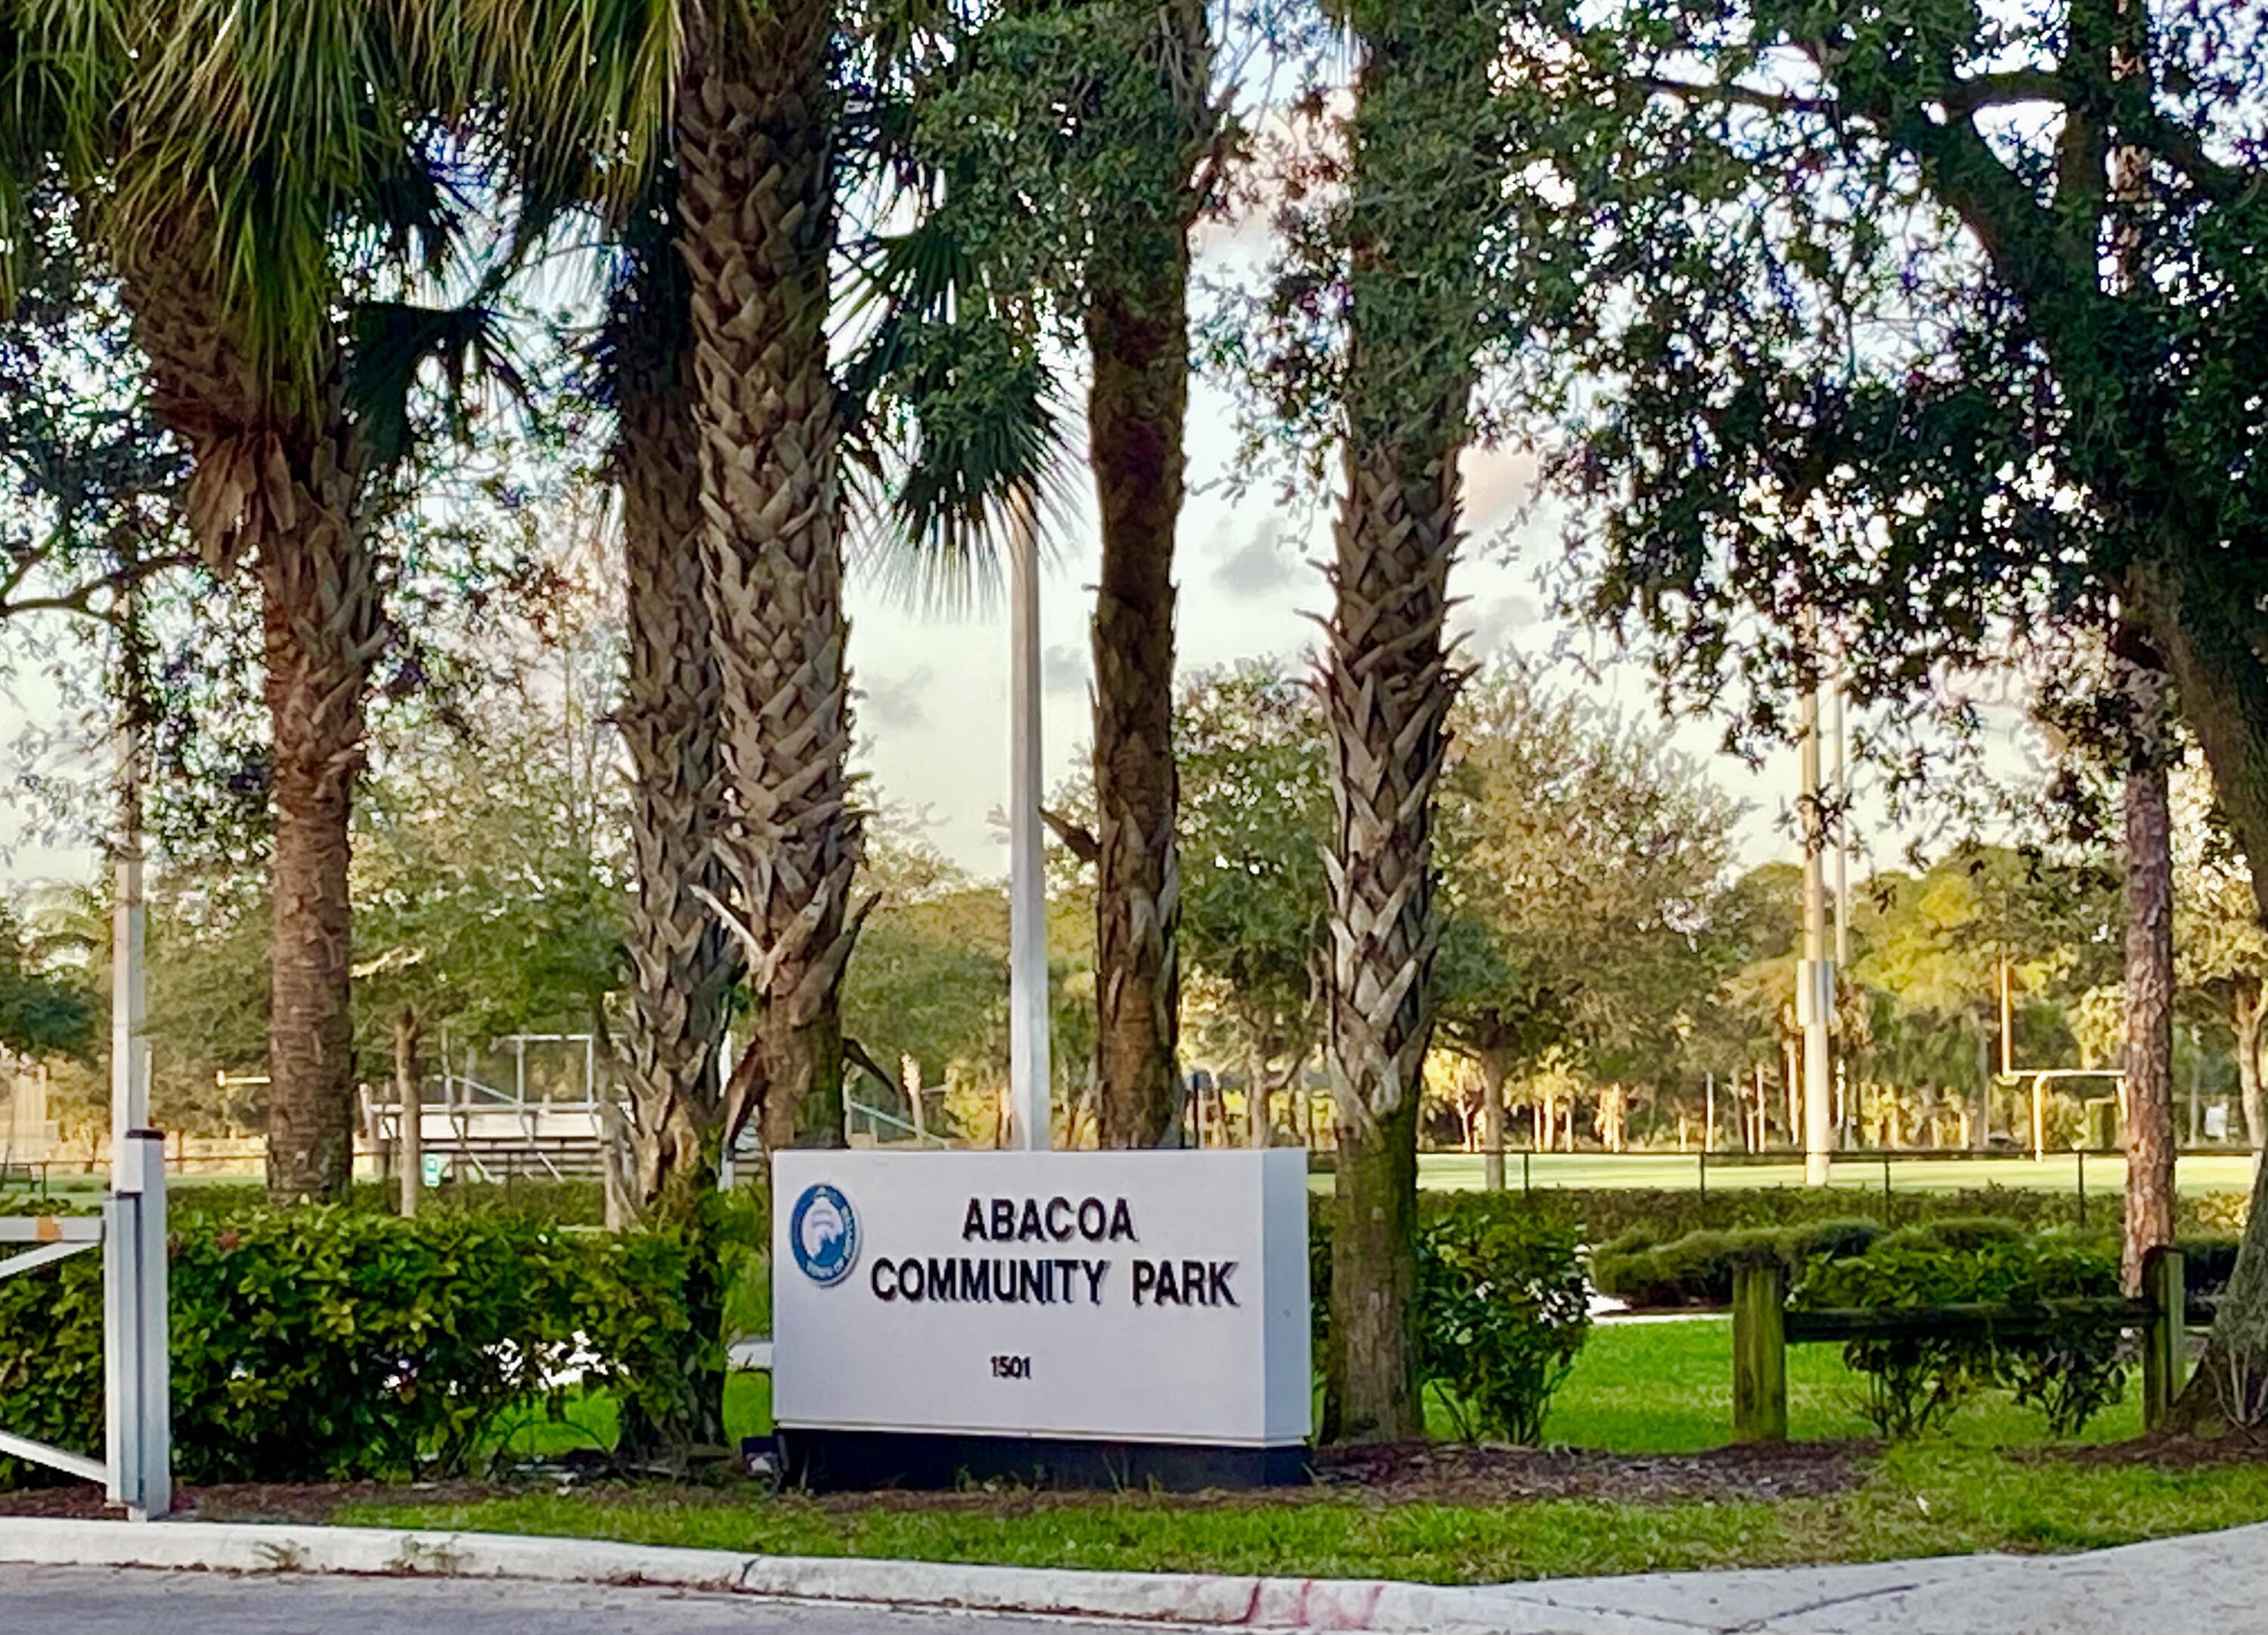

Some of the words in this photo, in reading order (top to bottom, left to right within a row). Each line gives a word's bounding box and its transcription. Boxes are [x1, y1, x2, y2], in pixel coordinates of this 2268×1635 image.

[962, 1197, 1138, 1242] ABACOA
[872, 1258, 1110, 1305] COMMUNITY
[1133, 1260, 1238, 1306] PARK
[991, 1356, 1030, 1379] 1501
